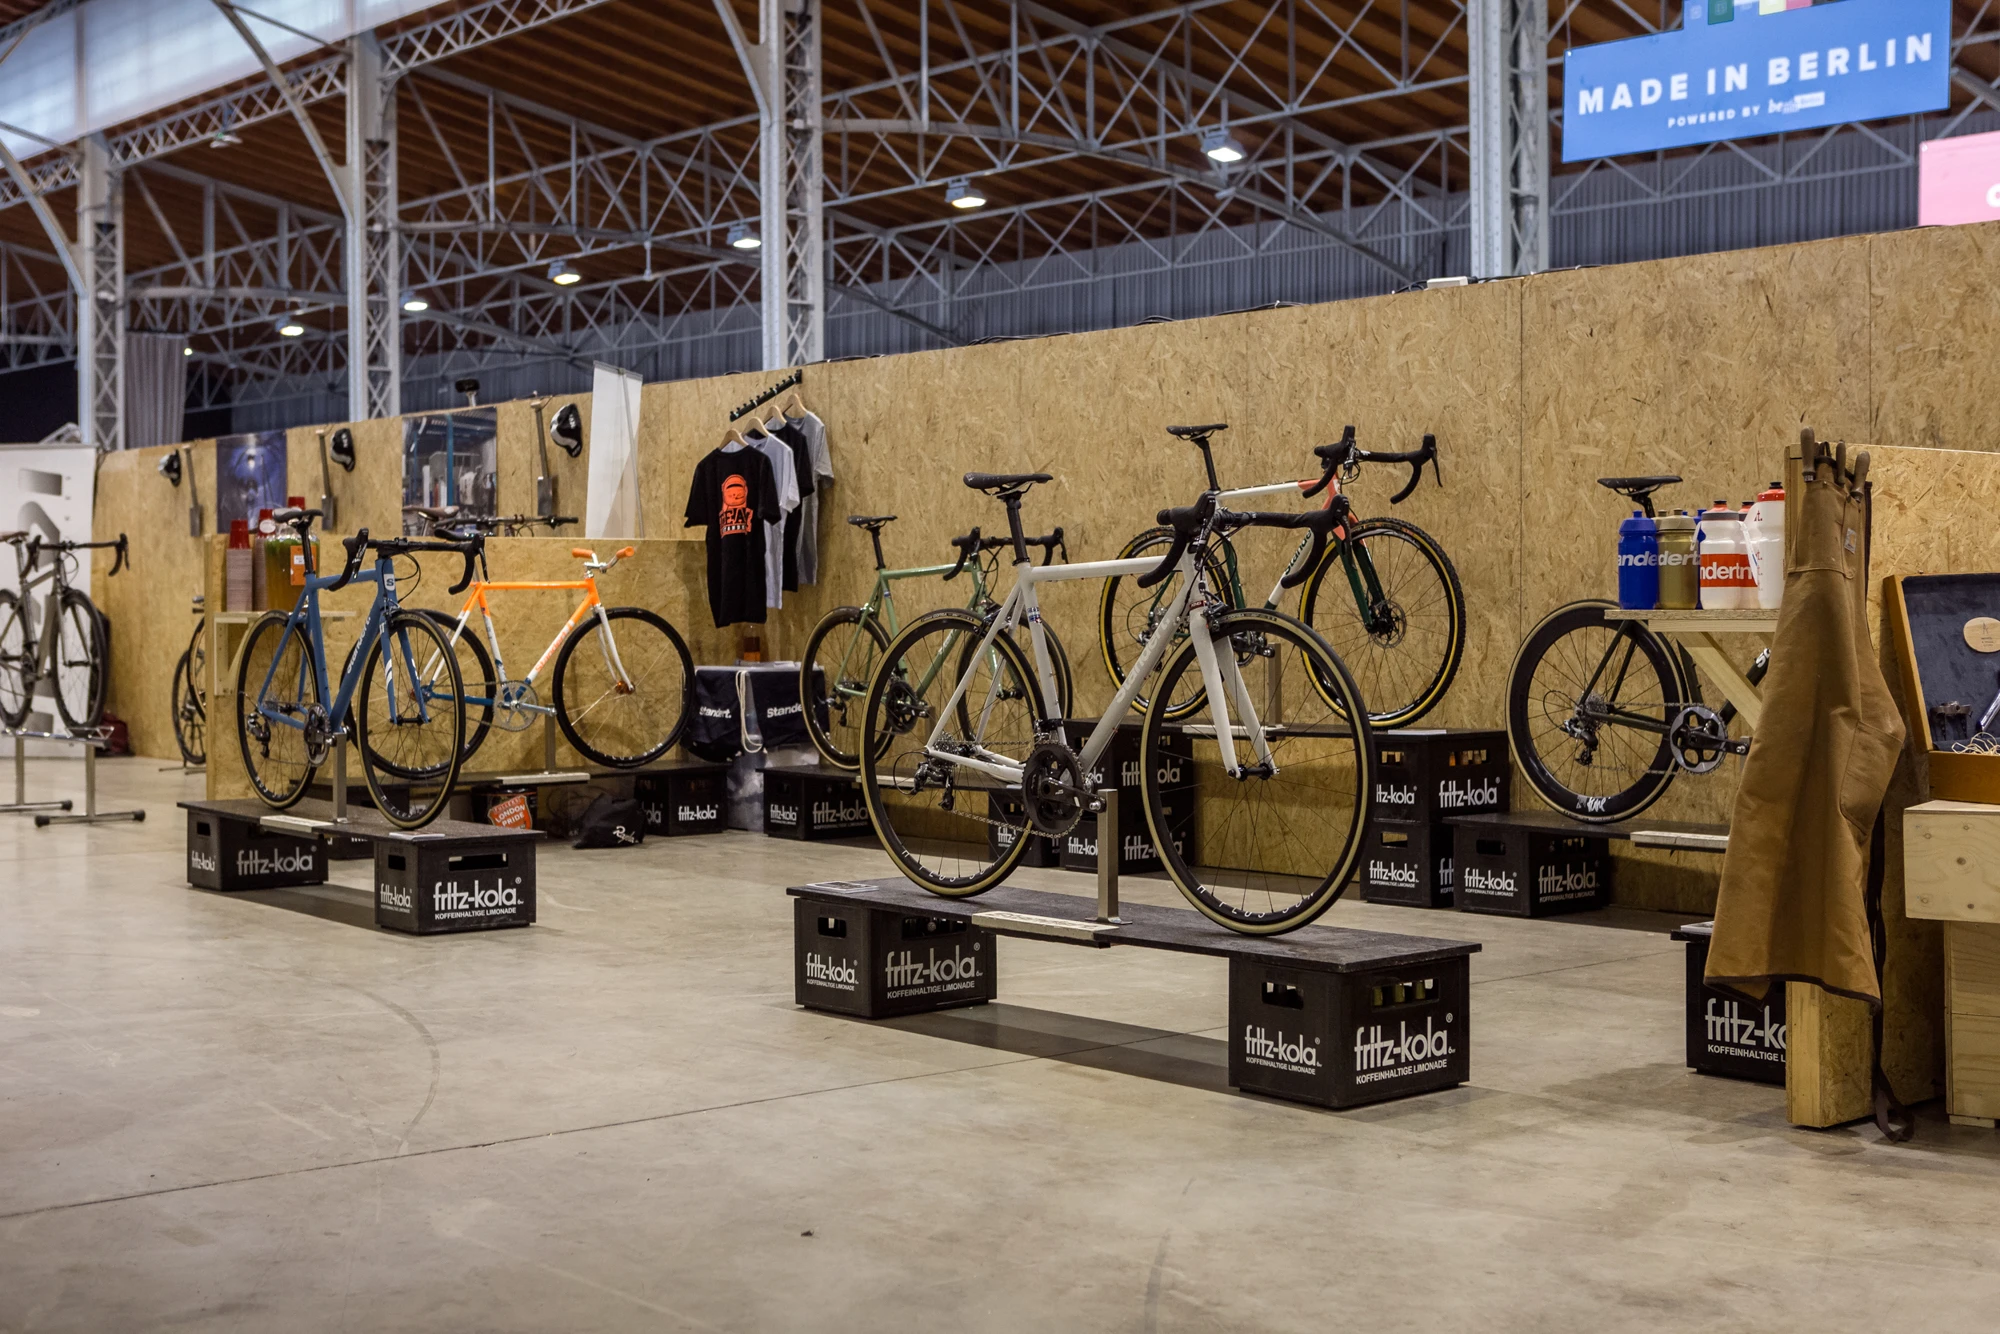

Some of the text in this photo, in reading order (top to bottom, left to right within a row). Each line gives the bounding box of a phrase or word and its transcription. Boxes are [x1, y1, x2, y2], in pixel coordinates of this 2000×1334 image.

[1579, 32, 1933, 115] MADE IN BERLIN
[1667, 108, 1736, 129] POWERED
[1742, 104, 1760, 118] BY
[495, 803, 526, 823] LONDON
[502, 811, 525, 827] PRIDE
[435, 907, 517, 920] KOFFEINHALTIGE LIMONADE
[807, 979, 855, 992] KOFFEINHALTIGE LIMONADE
[887, 980, 976, 999] KOFFEINHALTIGE LIMONADE
[1707, 1044, 1779, 1062] KOFFEINHALTIGE
[1246, 1056, 1316, 1075] KOFFEINHALTIGE LIMONADE
[1356, 1058, 1448, 1085] KOFFEINHALTIGE LIMONADE
